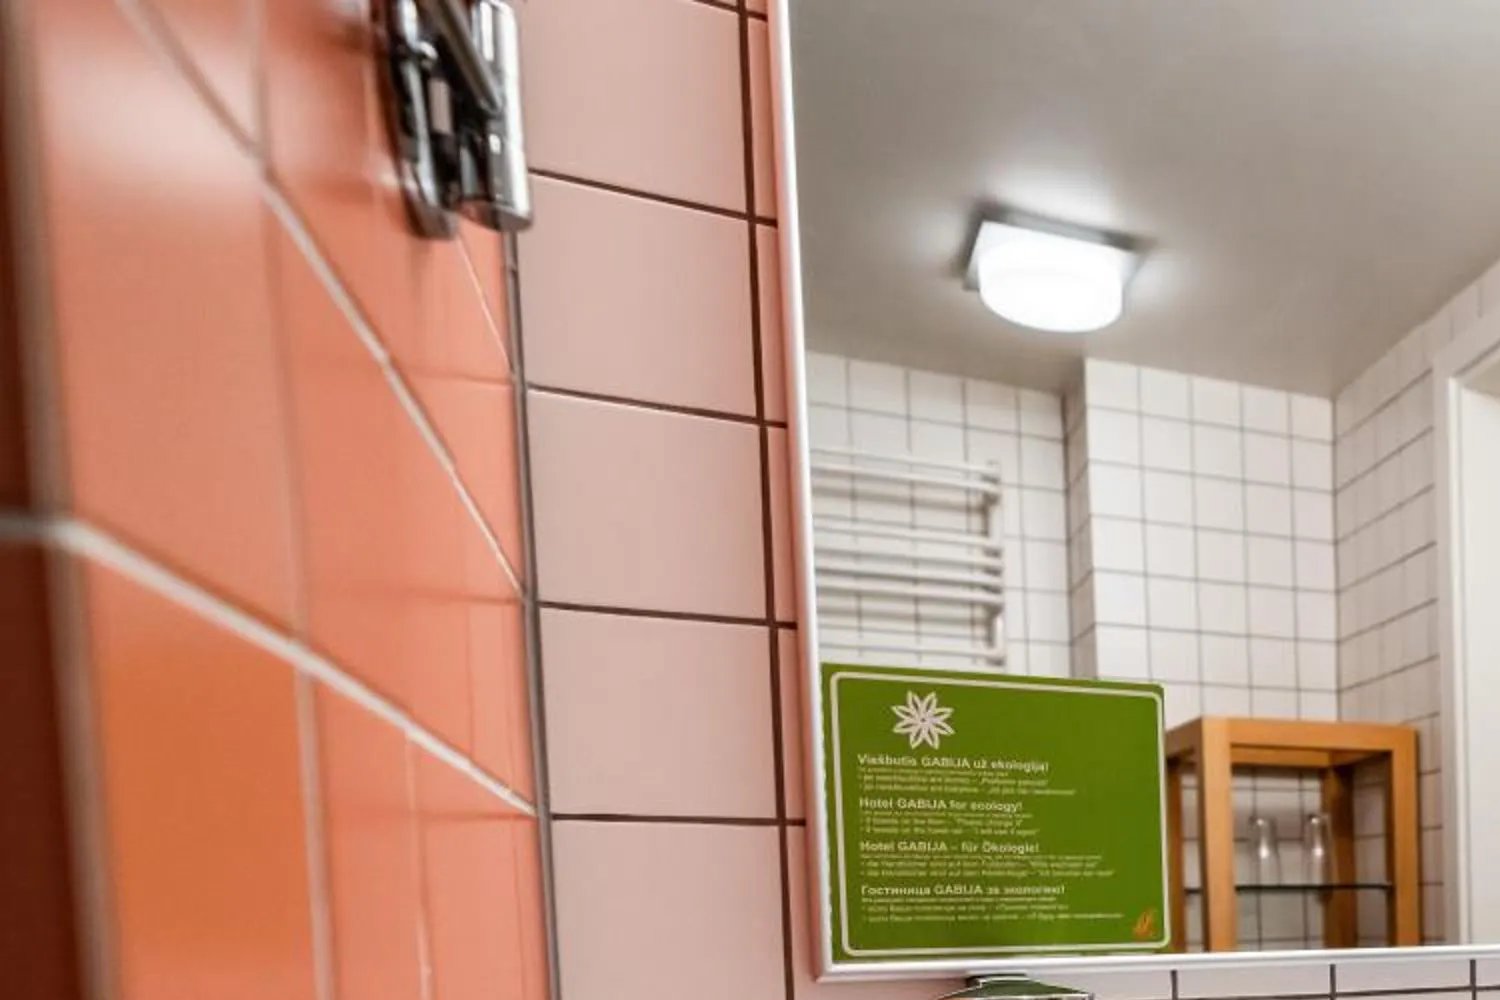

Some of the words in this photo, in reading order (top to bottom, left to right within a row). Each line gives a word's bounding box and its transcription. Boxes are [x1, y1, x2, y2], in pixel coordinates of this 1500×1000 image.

[921, 755, 970, 768] GABIJA
[859, 798, 894, 809] Hotel
[897, 798, 947, 810] GABIJA
[949, 799, 968, 810] for
[970, 801, 1023, 813] ecology!
[859, 841, 895, 852] Hotel
[897, 841, 948, 853] GABIJA
[933, 883, 983, 896] GABIJA
